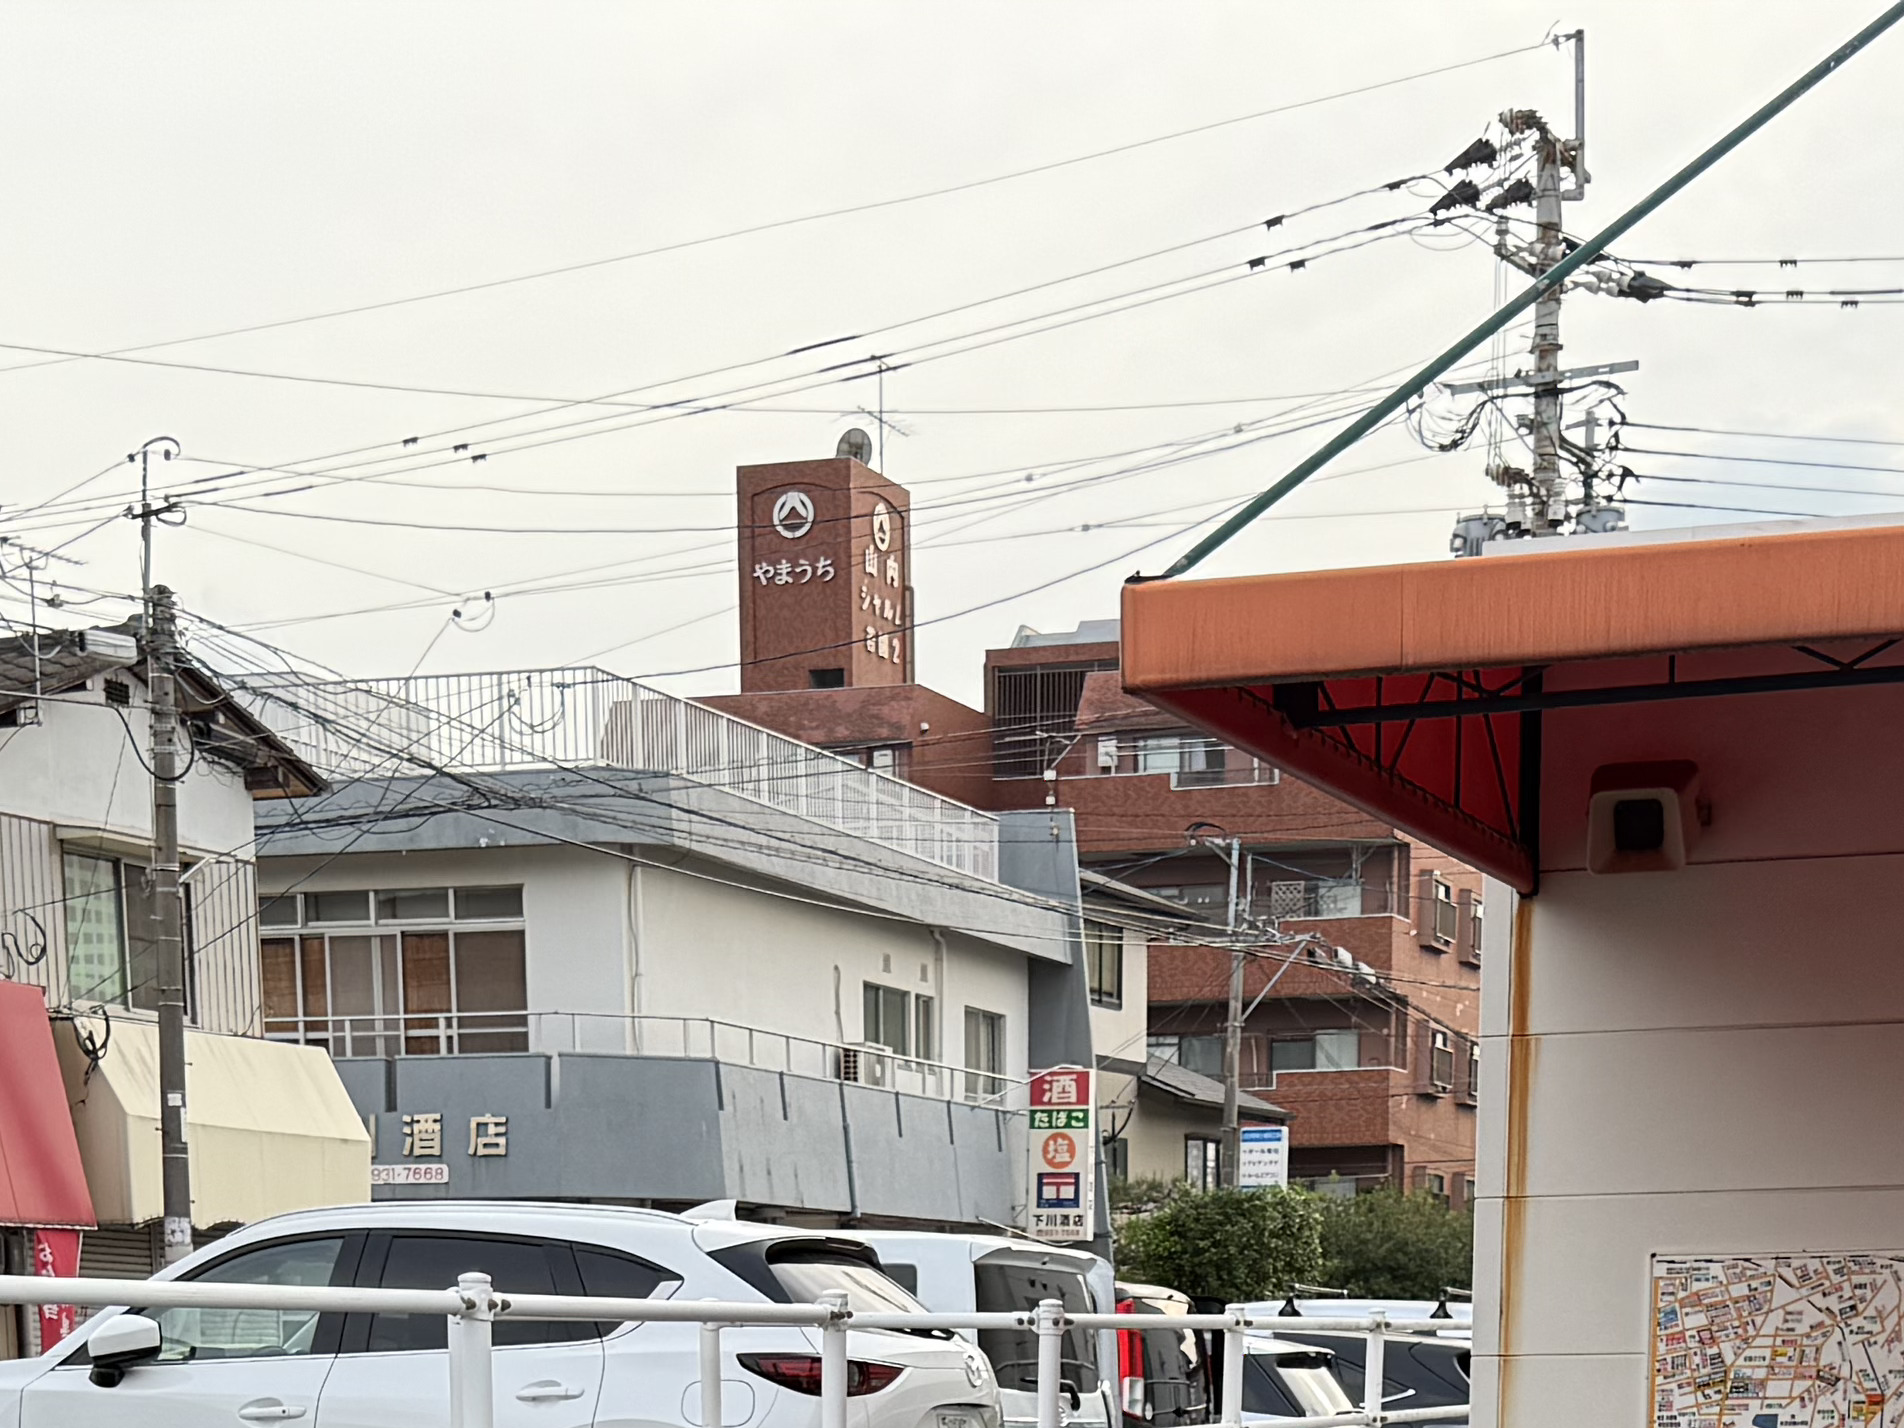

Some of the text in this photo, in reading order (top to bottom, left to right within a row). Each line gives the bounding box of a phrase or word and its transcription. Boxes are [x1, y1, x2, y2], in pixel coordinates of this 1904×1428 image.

[753, 556, 835, 586] やまうち
[1042, 1074, 1078, 1104] 酒
[1033, 1111, 1085, 1128] たばこ
[1047, 1137, 1073, 1163] 塩
[1032, 1213, 1084, 1227] 下川酒店
